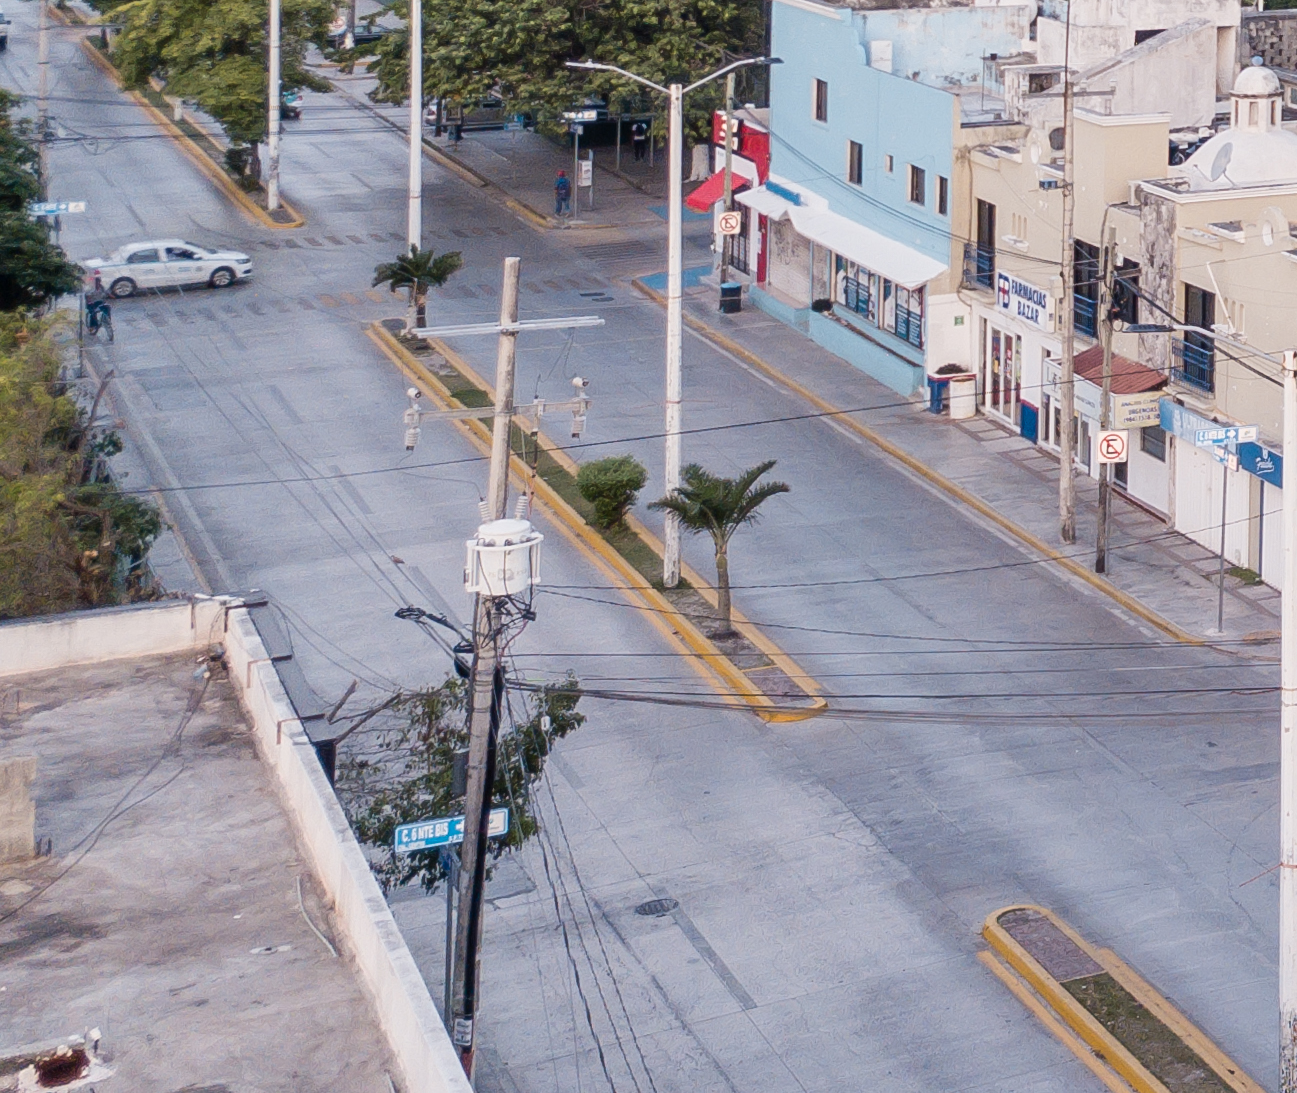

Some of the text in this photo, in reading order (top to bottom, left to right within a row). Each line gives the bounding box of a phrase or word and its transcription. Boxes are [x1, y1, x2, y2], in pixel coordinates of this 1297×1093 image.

[1011, 279, 1047, 310] FARMACIAS
[1017, 300, 1039, 325] BAZAR
[418, 825, 434, 839] NTE
[435, 822, 449, 838] BIS
